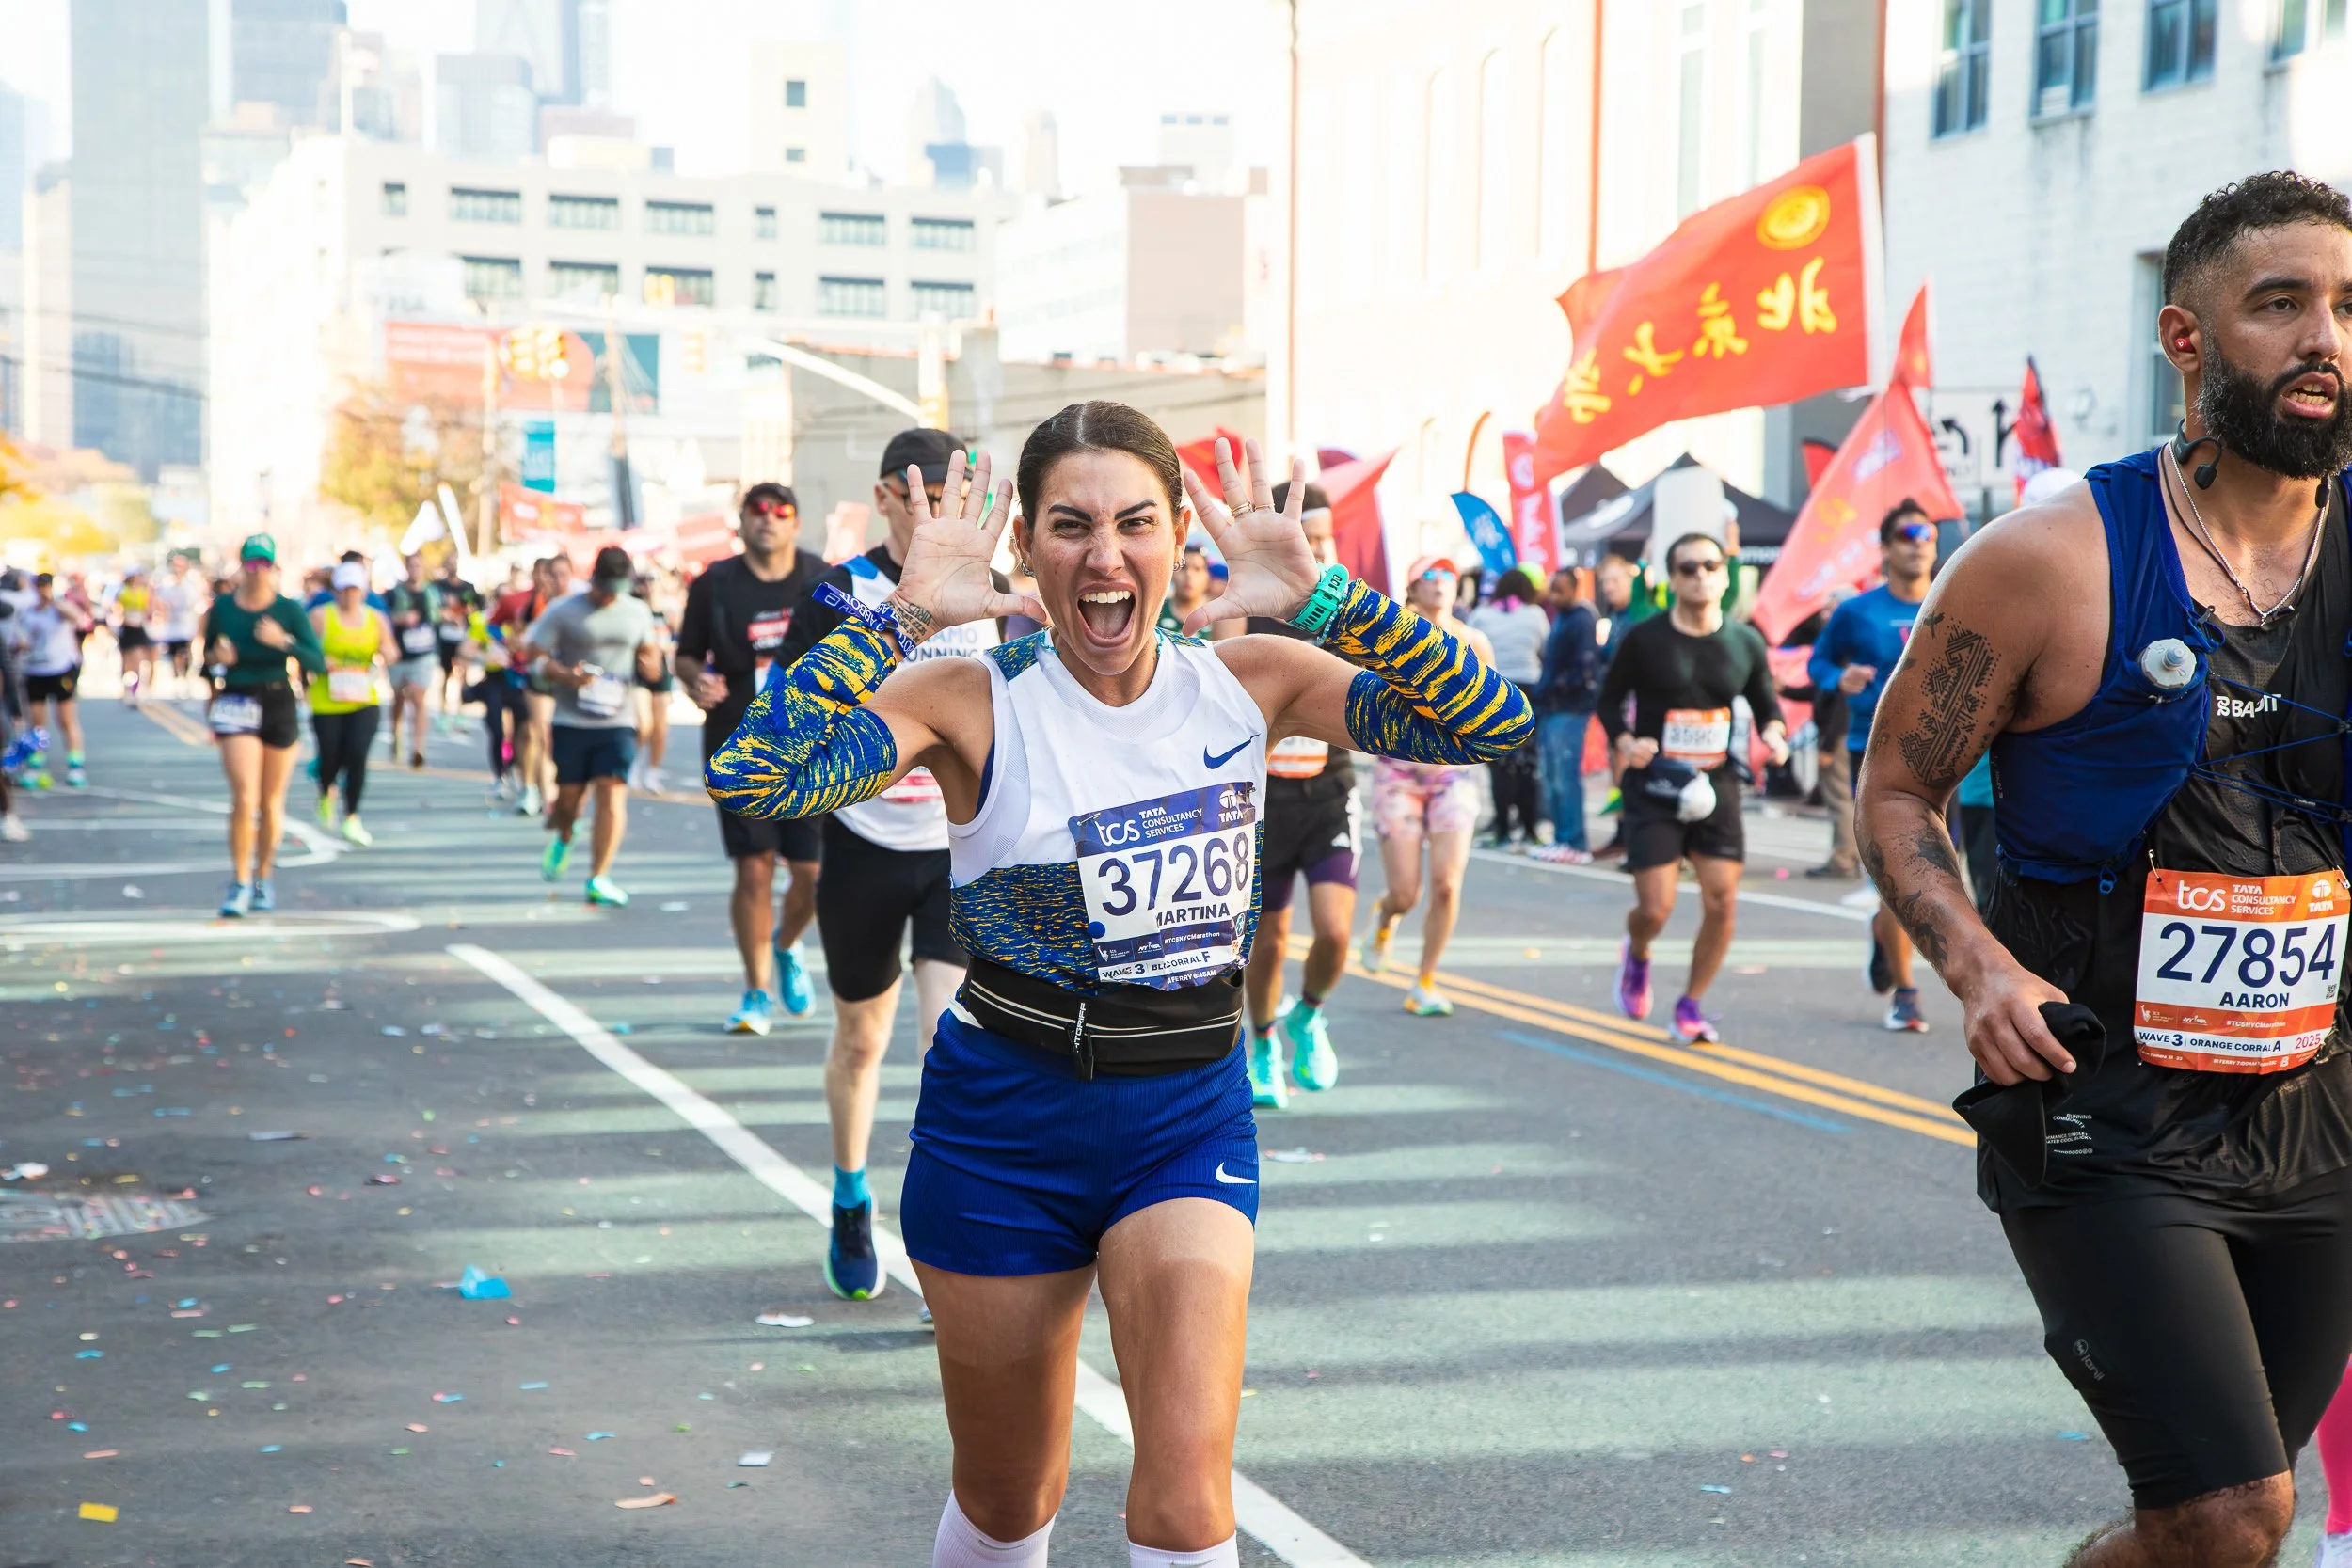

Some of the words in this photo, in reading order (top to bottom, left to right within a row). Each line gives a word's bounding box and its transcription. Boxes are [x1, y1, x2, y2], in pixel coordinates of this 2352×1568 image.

[1139, 806, 1167, 819] TATA
[1141, 808, 1203, 829] CONSULTANCY
[1218, 809, 1244, 823] TATA
[1095, 819, 1141, 847] tcs
[1145, 823, 1185, 839] SERVICES
[1098, 832, 1250, 917] 37268
[2176, 879, 2227, 912] tcs
[2232, 884, 2263, 895] TATA
[2231, 895, 2297, 906] CONSULTANCY
[2308, 900, 2334, 913] TATA
[2231, 905, 2275, 916] SERVICES
[1164, 931, 1221, 944] #TCSNYCMarathon
[1135, 963, 1146, 975] 3
[1201, 951, 1212, 963] F
[2156, 921, 2337, 989] 27854
[2219, 991, 2290, 1009] AARON
[2138, 1032, 2170, 1044] WAVE
[2171, 1034, 2184, 1047] 3
[2189, 1037, 2233, 1052] ORANGE
[2233, 1042, 2272, 1053] CORRAL
[2272, 1040, 2282, 1053] A
[2295, 1033, 2322, 1051] 2025
